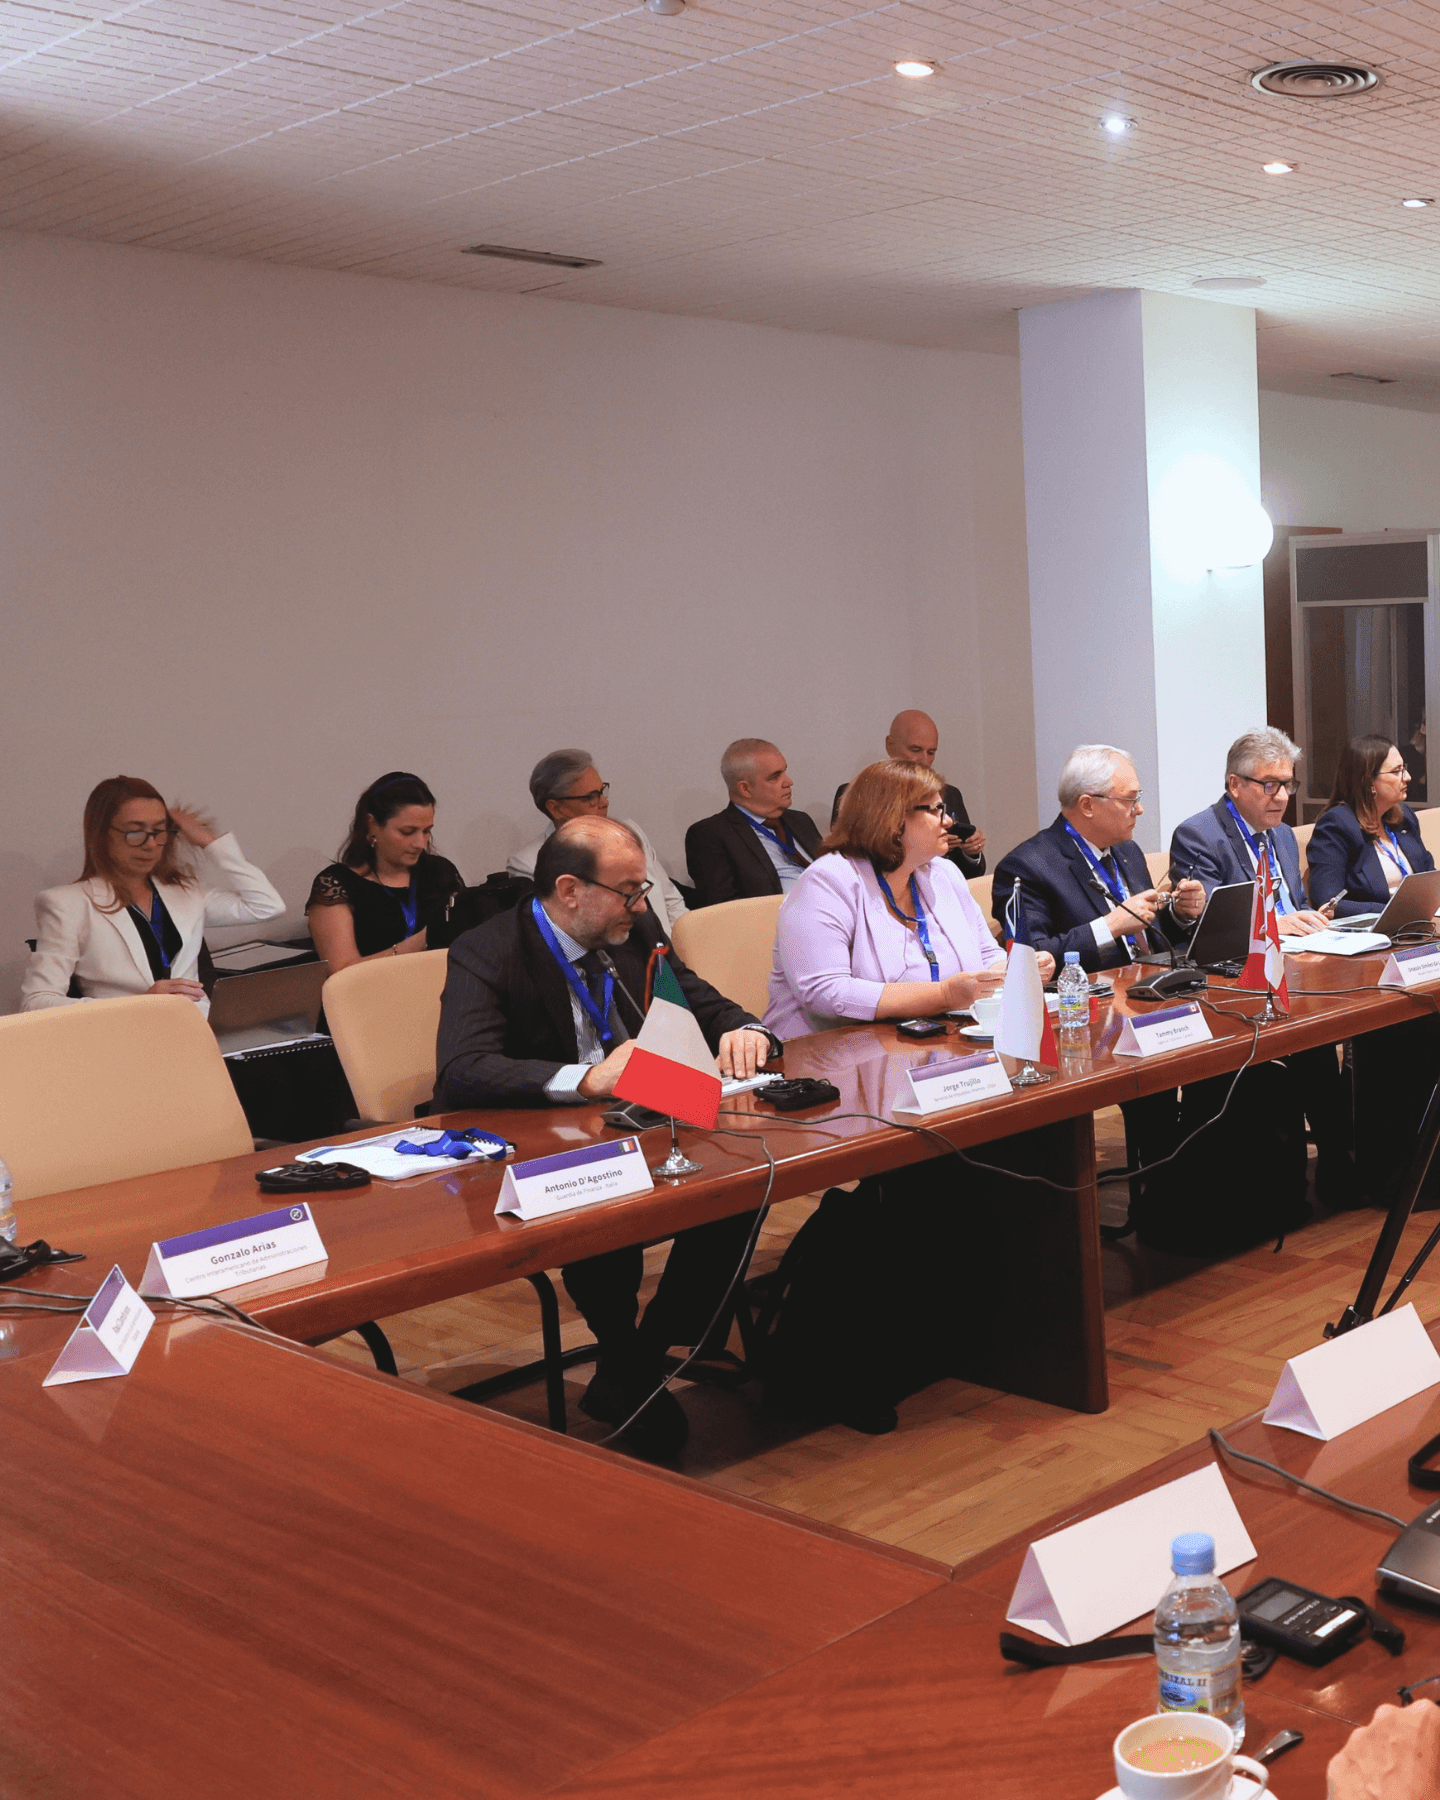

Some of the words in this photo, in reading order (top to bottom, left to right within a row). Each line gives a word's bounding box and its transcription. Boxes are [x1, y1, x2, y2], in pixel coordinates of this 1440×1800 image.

[943, 1084, 960, 1093] Jorge
[960, 1077, 981, 1089] Trujillo
[545, 1180, 578, 1194] Antonio
[578, 1168, 623, 1185] D'Agostino
[185, 1271, 207, 1284] Centro
[259, 1245, 308, 1263] Administraciones
[210, 1247, 251, 1265] Gonzalo
[252, 1240, 277, 1254] Arias
[234, 1264, 267, 1277] Tributarias
